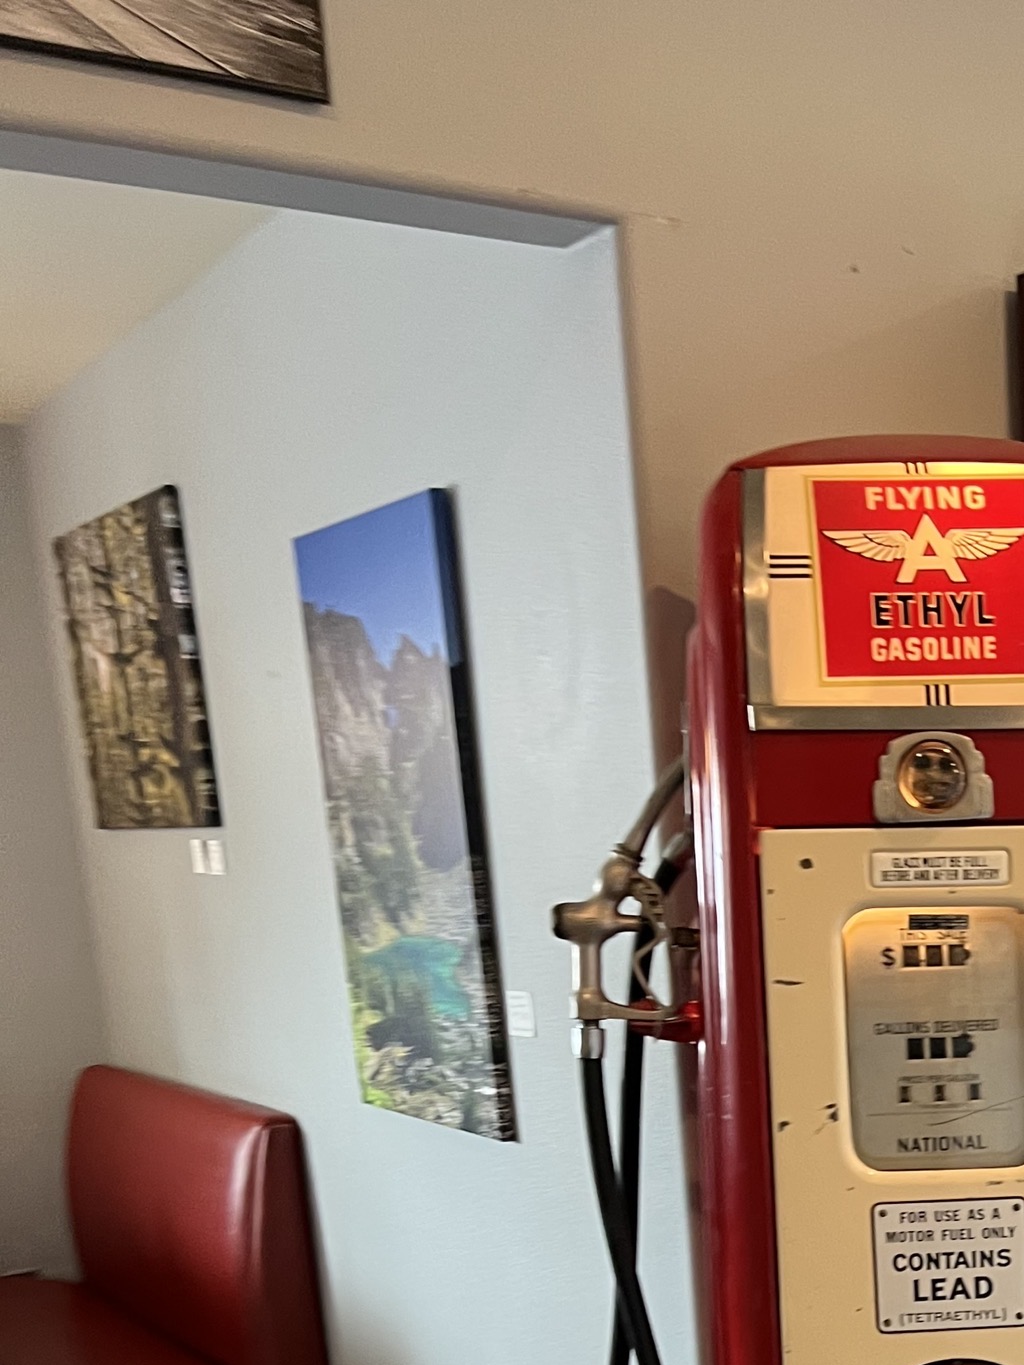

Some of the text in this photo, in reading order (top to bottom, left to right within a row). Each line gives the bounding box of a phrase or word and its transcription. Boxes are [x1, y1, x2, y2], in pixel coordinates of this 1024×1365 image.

[864, 485, 986, 511] FLYING
[896, 513, 968, 584] A
[870, 592, 997, 629] ETHYL
[870, 635, 998, 662] GASOLINE
[897, 1134, 988, 1153] NATIONAL
[899, 1207, 1001, 1224] FOR USE AS A
[885, 1226, 1016, 1243] MOTOR FUEL ONLY
[893, 1249, 1012, 1272] CONTAINS
[913, 1276, 993, 1302] LEAD
